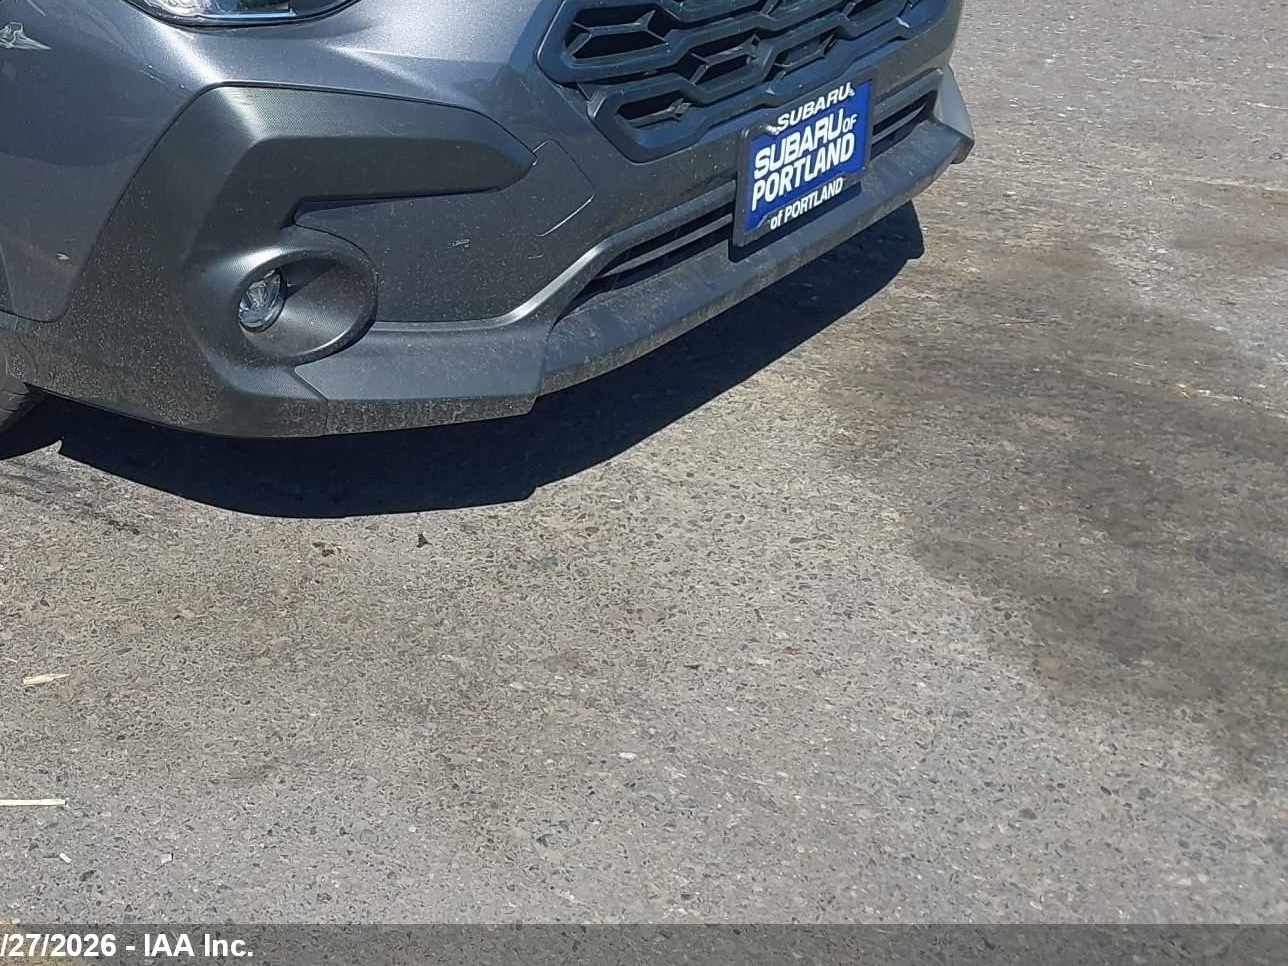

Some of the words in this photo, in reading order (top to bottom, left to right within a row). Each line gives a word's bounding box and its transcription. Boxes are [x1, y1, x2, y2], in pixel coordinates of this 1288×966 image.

[777, 81, 852, 131] SUBARU
[752, 132, 856, 211] PORTLAND
[754, 108, 844, 180] SUBARU
[842, 114, 858, 133] OF
[770, 211, 785, 230] of
[784, 177, 845, 224] PORTLAND
